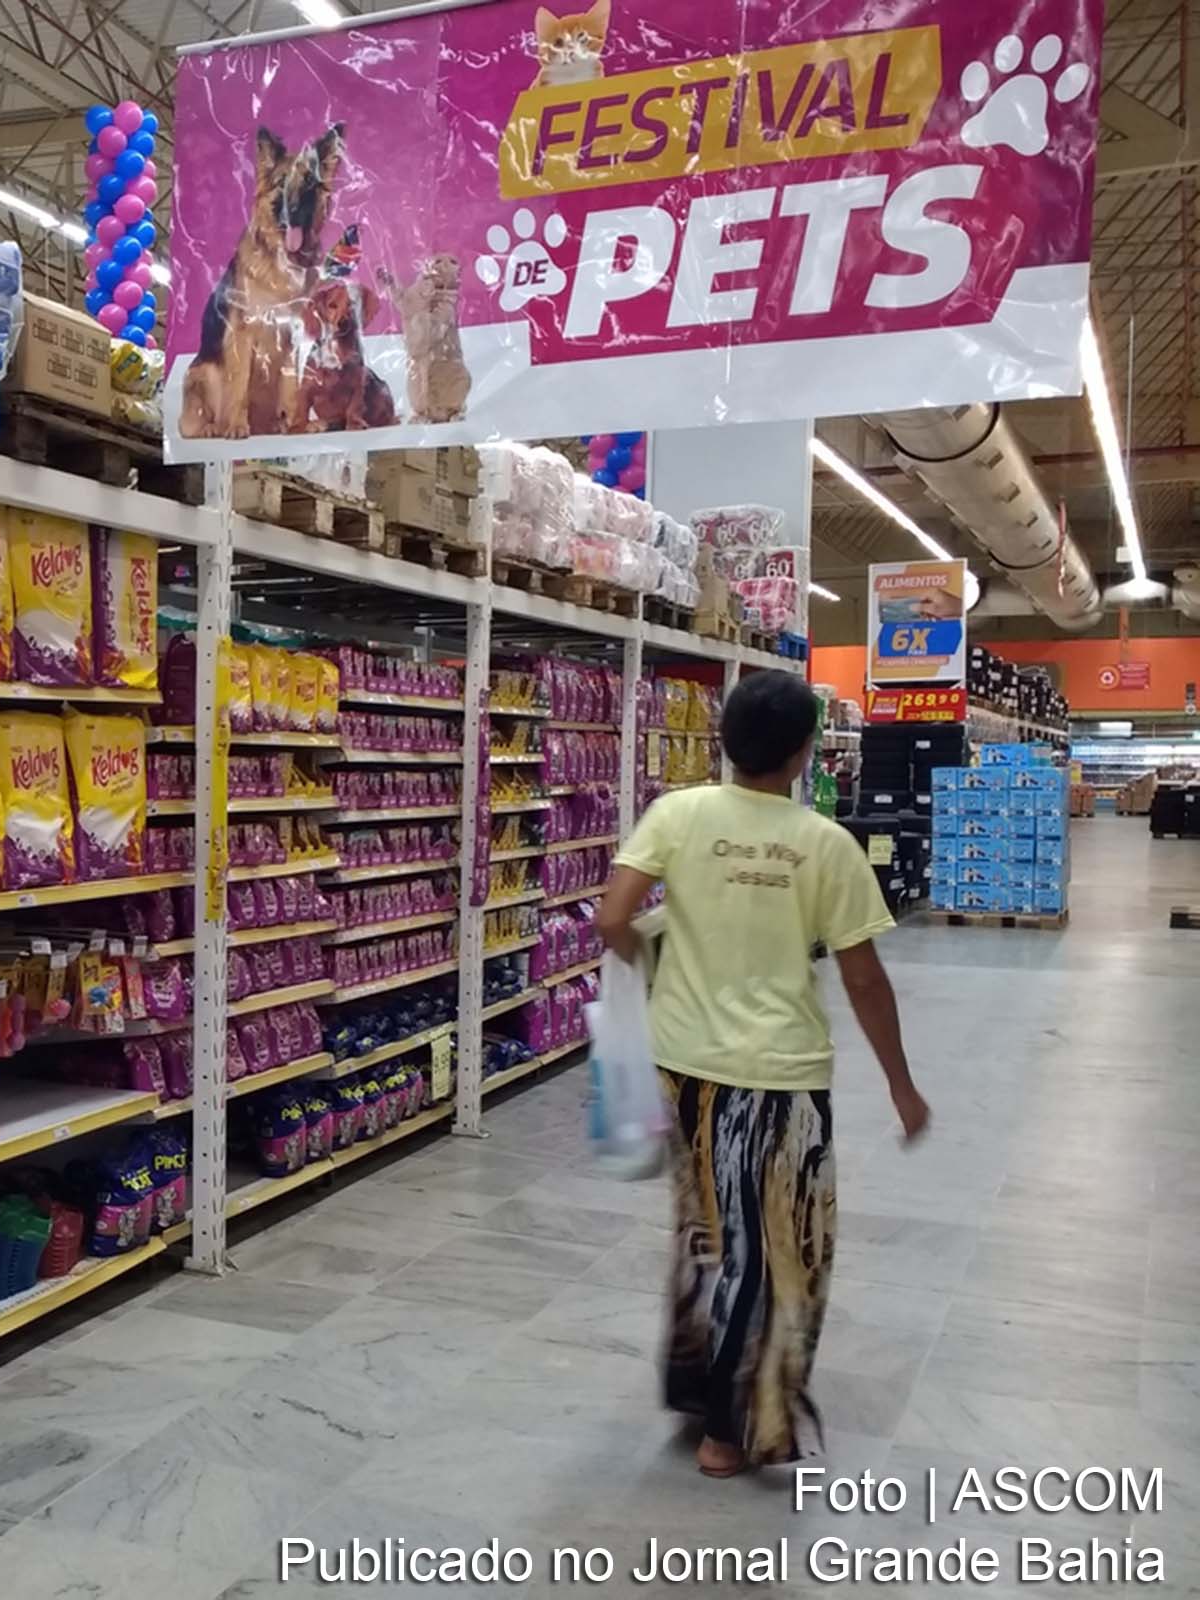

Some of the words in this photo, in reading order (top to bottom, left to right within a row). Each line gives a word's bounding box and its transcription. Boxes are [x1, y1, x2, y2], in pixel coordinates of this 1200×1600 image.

[531, 50, 912, 178] FESTIVAL
[511, 256, 550, 288] DE
[563, 162, 988, 339] PETS
[766, 559, 791, 579] 60
[879, 575, 948, 589] ALIMENTOS
[891, 628, 932, 652] 6X
[712, 839, 758, 860] One
[761, 842, 808, 869] Way
[725, 866, 792, 889] Jesus
